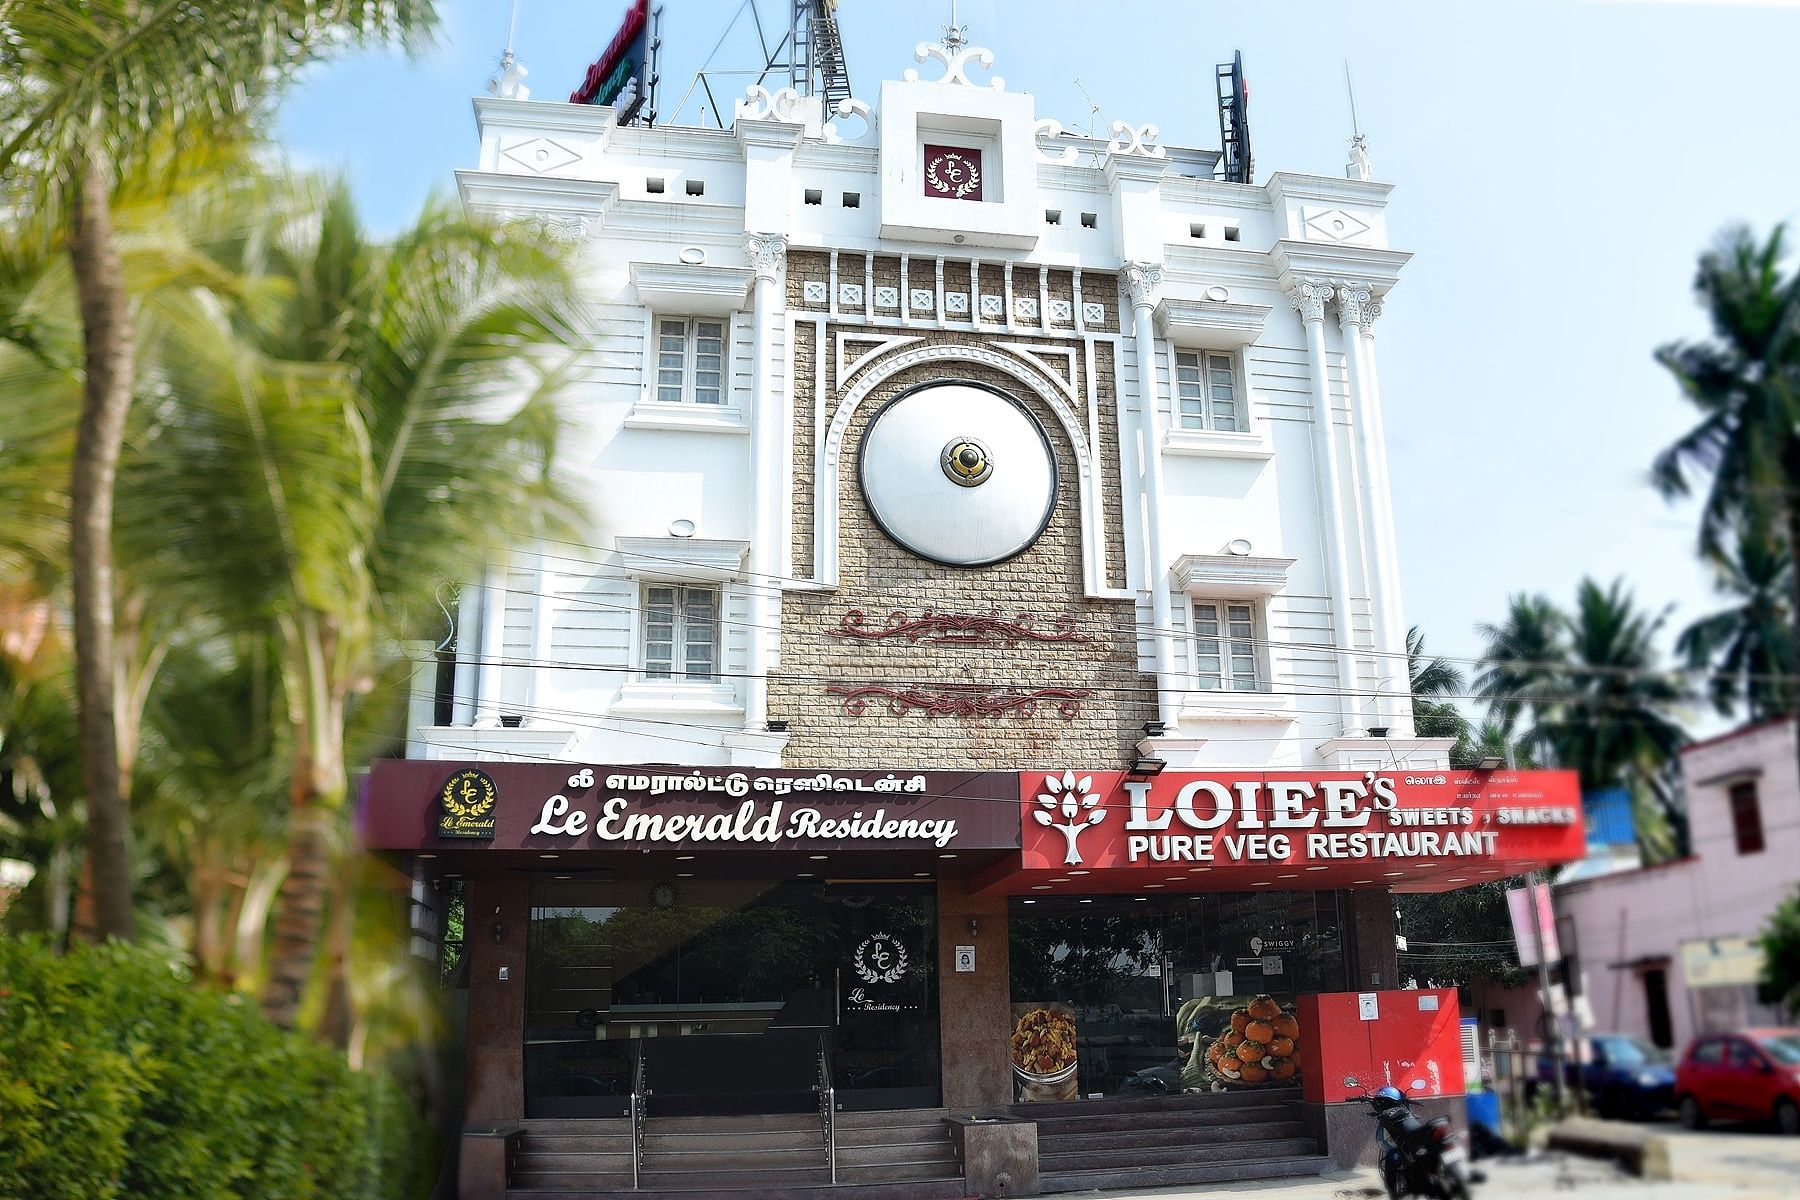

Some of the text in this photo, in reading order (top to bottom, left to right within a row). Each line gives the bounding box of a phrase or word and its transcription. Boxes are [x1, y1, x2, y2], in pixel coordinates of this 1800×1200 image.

[567, 768, 595, 788] லீ
[1123, 771, 1398, 830] LOIEE'S
[456, 816, 495, 828] Emerald
[530, 795, 958, 848] Le Emerald Residency
[1388, 806, 1474, 826] SWEETS
[1496, 807, 1576, 825] SNACKS
[1128, 831, 1499, 862] PURE VEG RESTAURANT
[863, 1002, 900, 1012] Residency
